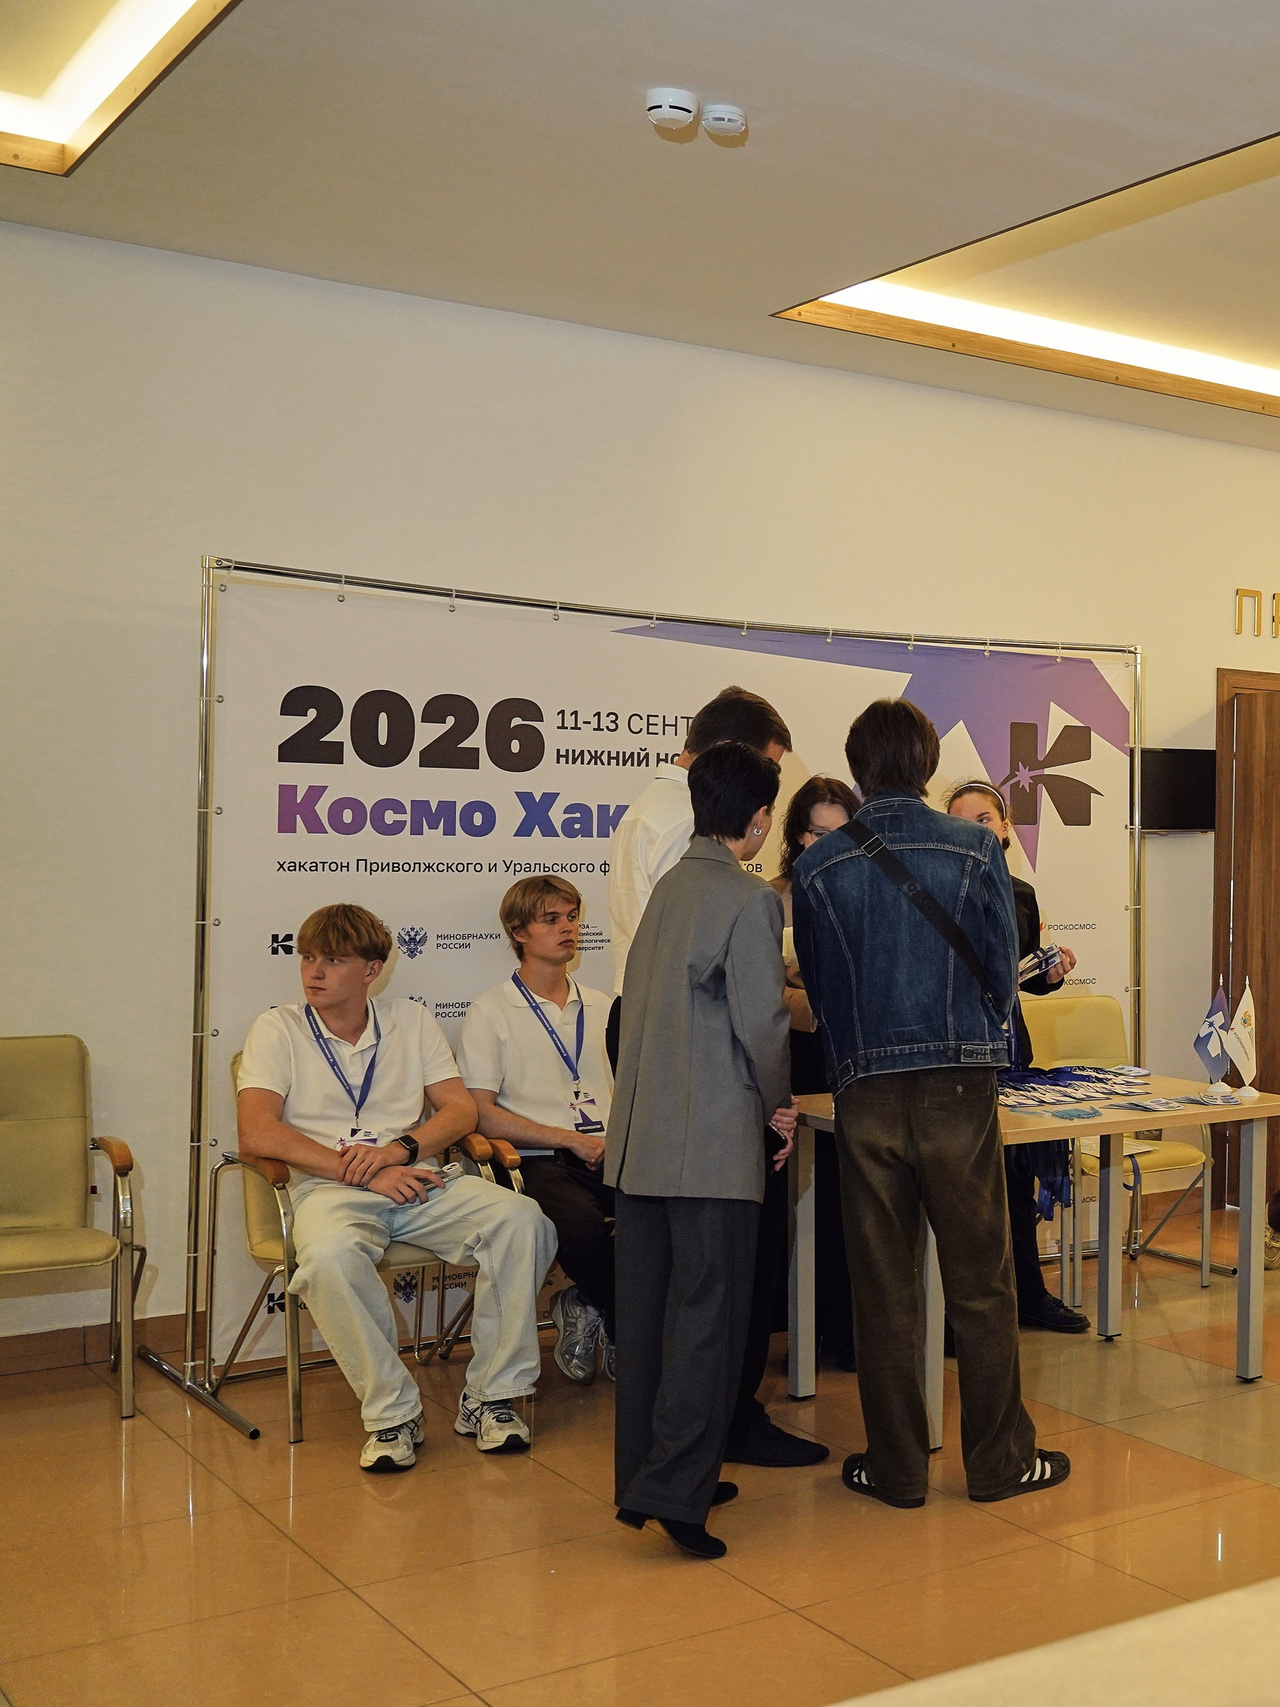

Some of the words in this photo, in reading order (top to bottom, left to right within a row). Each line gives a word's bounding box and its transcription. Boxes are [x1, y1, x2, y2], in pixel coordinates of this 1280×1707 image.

[277, 684, 546, 772] 2026
[556, 709, 619, 732] 11-13
[627, 713, 694, 736] СЕНТ
[277, 784, 498, 837] Космо
[513, 791, 629, 838] Хак
[276, 861, 349, 872] хакатон
[356, 859, 483, 876] Приволжского
[488, 863, 497, 873] и
[502, 860, 595, 876] Уральского
[436, 933, 501, 941] МИНОБРНАУКИ
[436, 942, 471, 950] РОССИИ
[1064, 978, 1097, 986] КОСМОС
[435, 1001, 474, 1010] МИНОБР
[432, 1270, 479, 1283] МНОБРН
[432, 1281, 467, 1291] РССИИ
